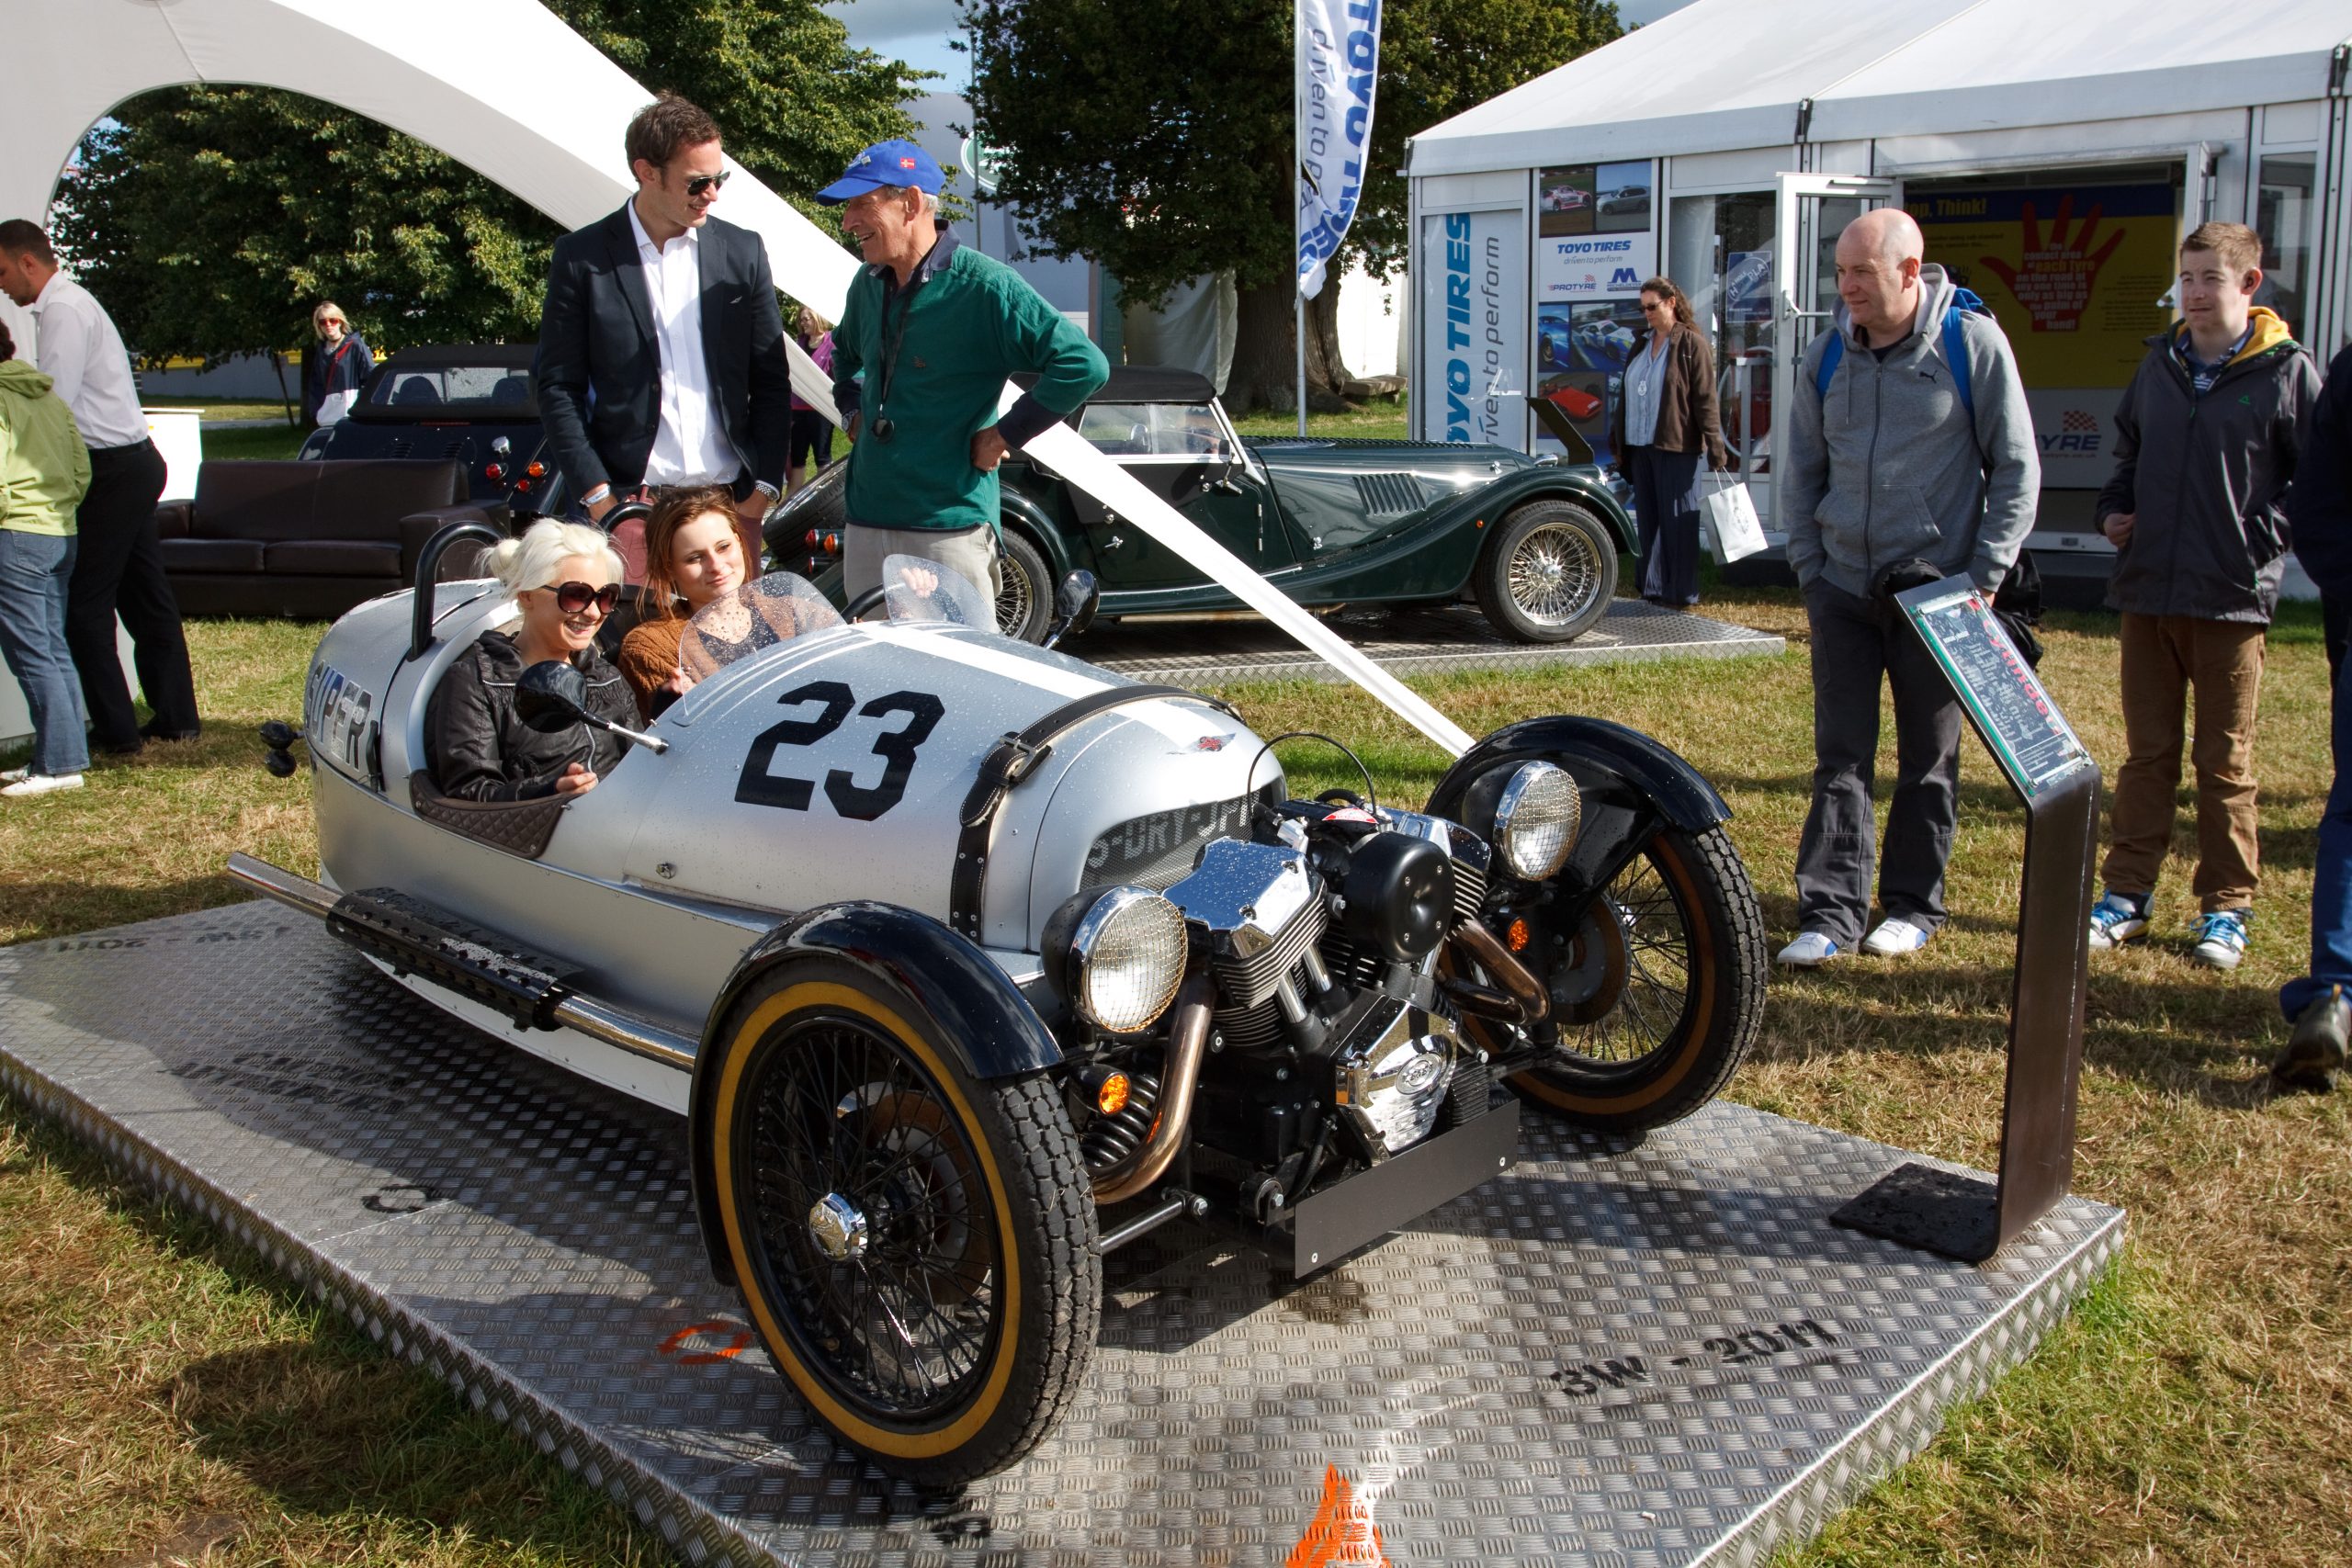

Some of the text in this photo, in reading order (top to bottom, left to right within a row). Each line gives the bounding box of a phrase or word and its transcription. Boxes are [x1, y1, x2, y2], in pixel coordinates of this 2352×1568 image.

[1307, 28, 1336, 119] driven
[1345, 0, 1378, 148] TOYO
[1309, 127, 1329, 156] to
[1936, 197, 1987, 217] Think!
[1557, 240, 1632, 254] TOYO TIRES
[1564, 255, 1586, 265] driven
[1594, 255, 1623, 265] perform
[2024, 251, 2083, 261] contact area
[2036, 260, 2067, 272] each
[2016, 272, 2086, 282] on the road at
[1554, 282, 1598, 292] PROTYRE
[2014, 281, 2088, 292] any one time is
[2018, 290, 2088, 301] only as big as
[2043, 300, 2071, 310] palm
[2072, 299, 2085, 310] of
[2033, 310, 2058, 321] your
[1446, 212, 1471, 445] OYO TIRES
[2045, 318, 2076, 330] hand!
[1479, 236, 1504, 443] riven to perform
[306, 660, 373, 772] SUPER
[734, 681, 945, 822] 23
[57, 936, 150, 953] 2011
[1703, 1318, 1839, 1364] 2011
